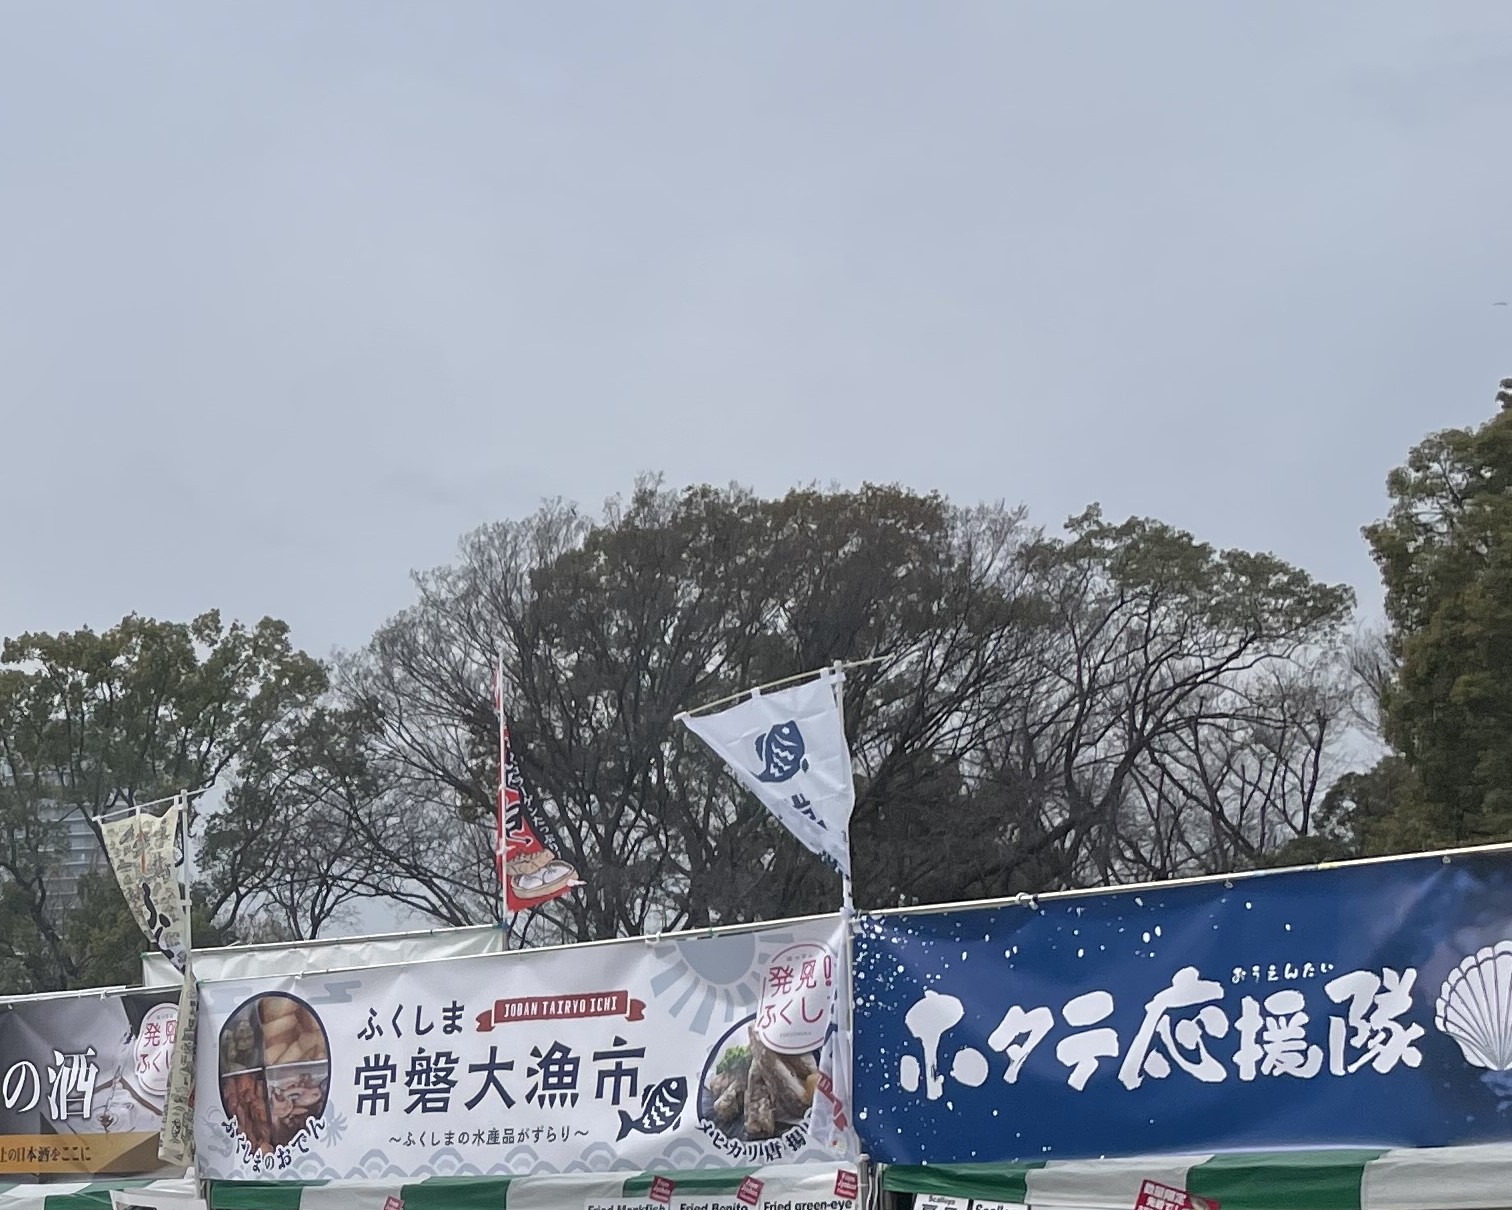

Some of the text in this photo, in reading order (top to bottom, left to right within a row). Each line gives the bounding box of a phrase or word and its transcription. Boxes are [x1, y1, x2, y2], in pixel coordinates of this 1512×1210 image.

[1231, 962, 1334, 984] おうえんたい
[357, 1000, 465, 1040] ふくしま
[504, 996, 618, 1018] JOBAN TAIRYO ICHI
[757, 996, 825, 1029] ふくし
[900, 966, 1425, 1100] ホタテ応援隊
[354, 1036, 646, 1115] 常磐大漁市
